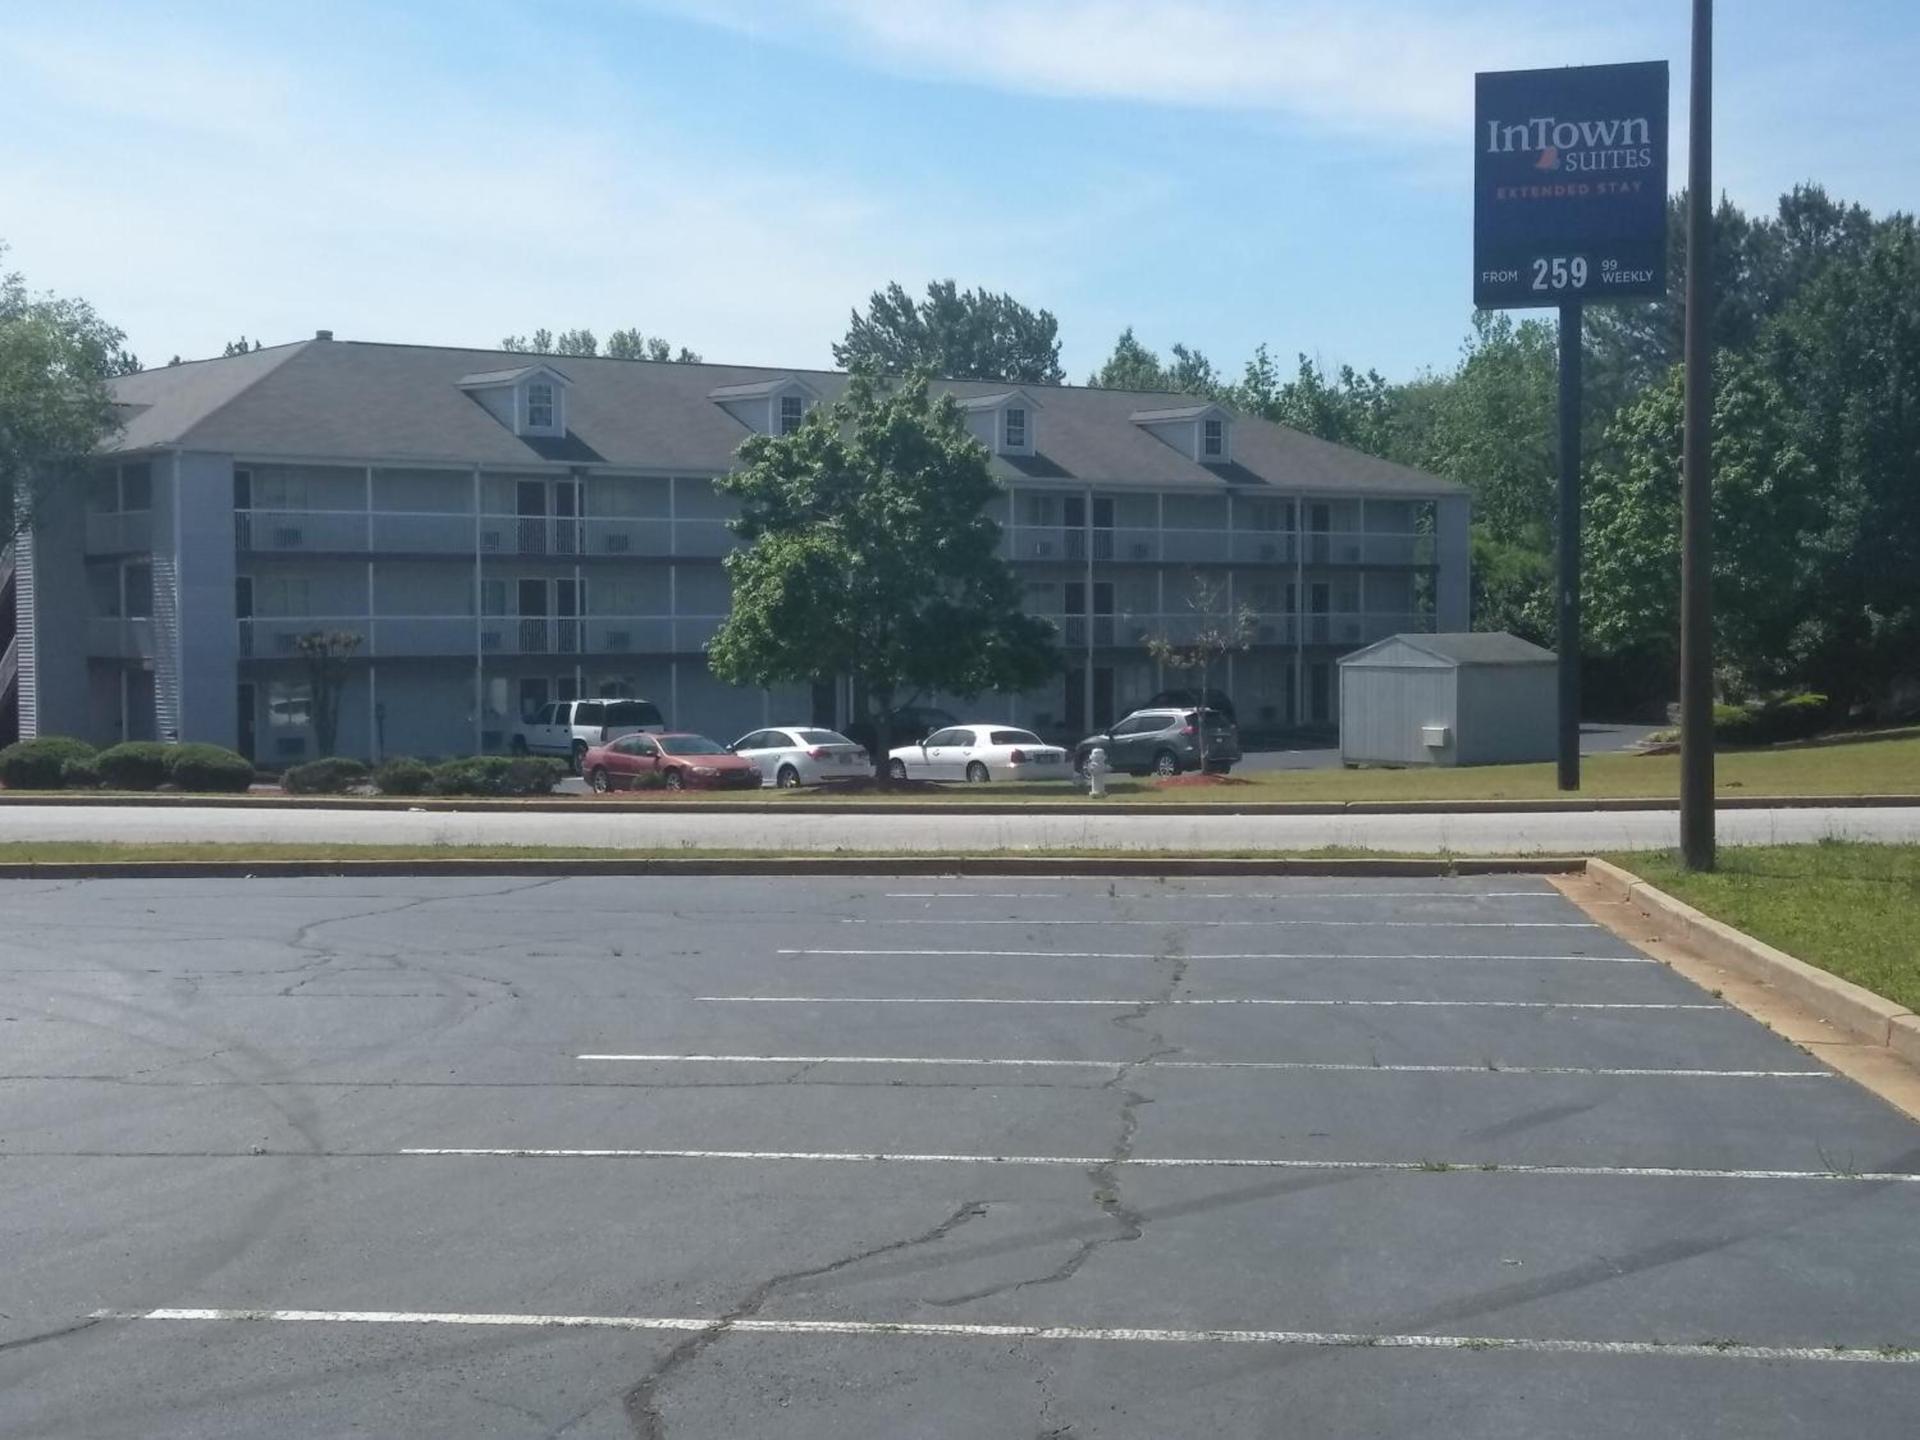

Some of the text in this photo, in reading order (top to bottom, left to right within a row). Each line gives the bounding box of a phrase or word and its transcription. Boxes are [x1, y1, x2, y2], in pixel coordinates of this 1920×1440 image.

[1487, 117, 1650, 152] InTown
[1565, 149, 1652, 171] SUITES
[1497, 181, 1643, 200] EXTENDED STAY
[1482, 257, 1588, 291] FROM 259
[1601, 259, 1618, 270] 99
[1602, 270, 1653, 283] WEEKLY
